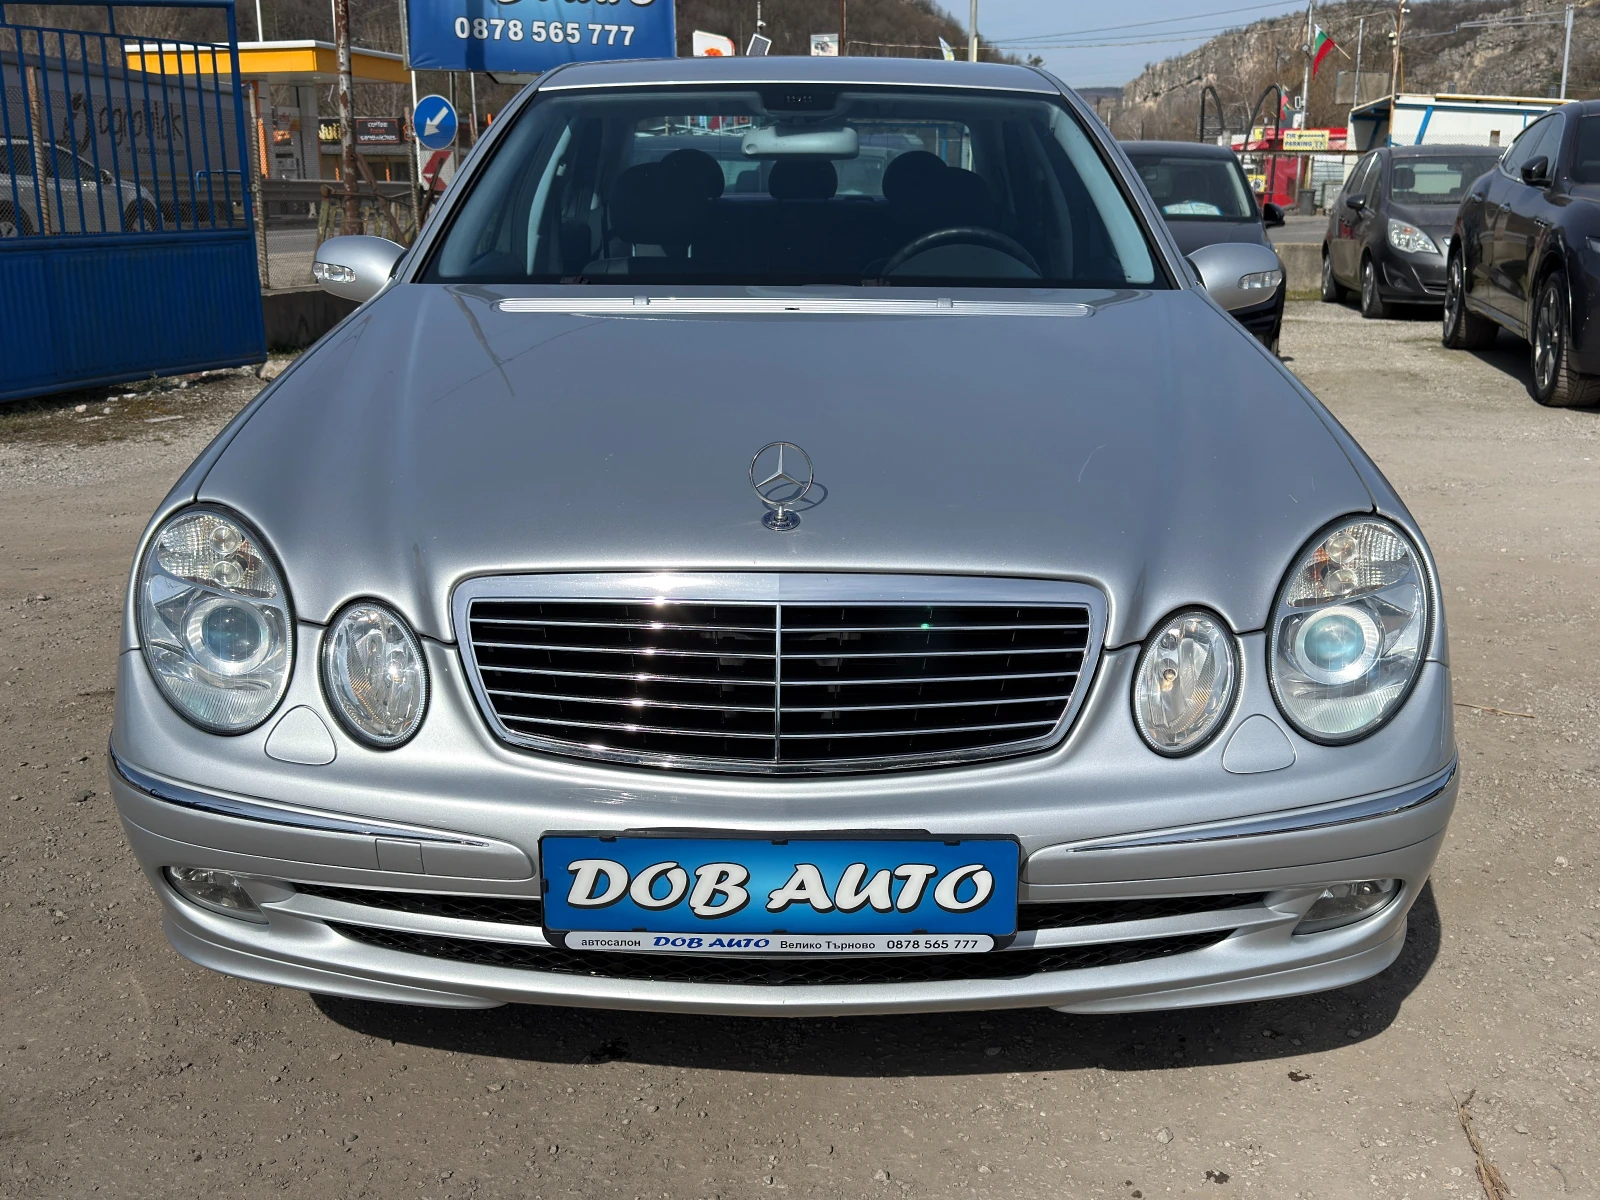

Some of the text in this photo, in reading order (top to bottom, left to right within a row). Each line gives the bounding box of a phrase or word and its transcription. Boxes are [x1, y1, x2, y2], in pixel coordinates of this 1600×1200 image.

[454, 16, 636, 46] 0878 565 777
[567, 858, 996, 920] DOB AUTO
[581, 936, 979, 952] автосалон DOB AUTO Велико Търново 0878 565 777
